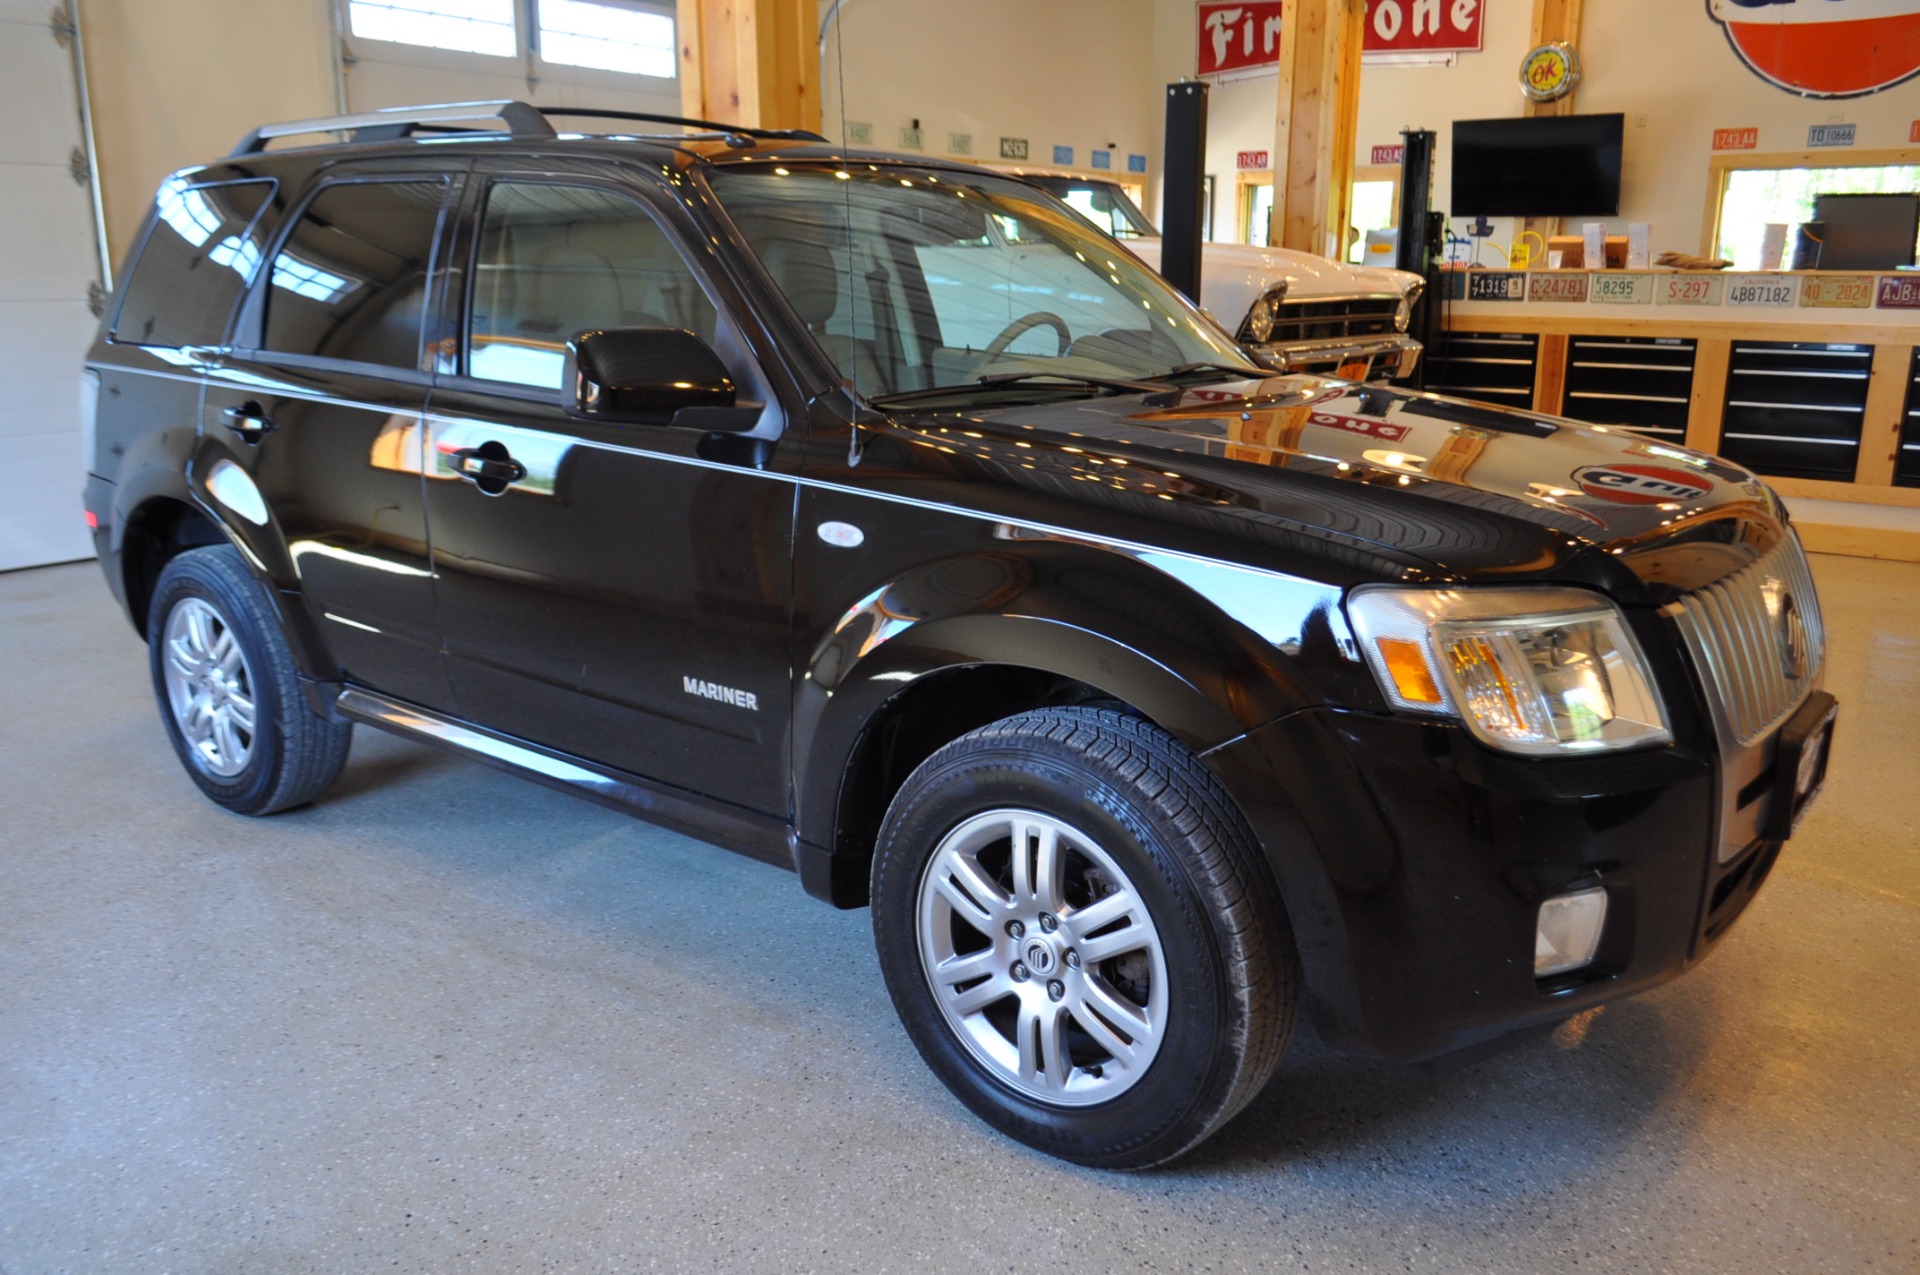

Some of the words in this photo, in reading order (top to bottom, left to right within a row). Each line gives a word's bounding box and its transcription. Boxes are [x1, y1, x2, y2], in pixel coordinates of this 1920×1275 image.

[1205, 0, 1477, 67] Firone
[1479, 279, 1508, 294] 1319
[1602, 280, 1635, 296] 8295
[683, 675, 759, 711] MARINER
